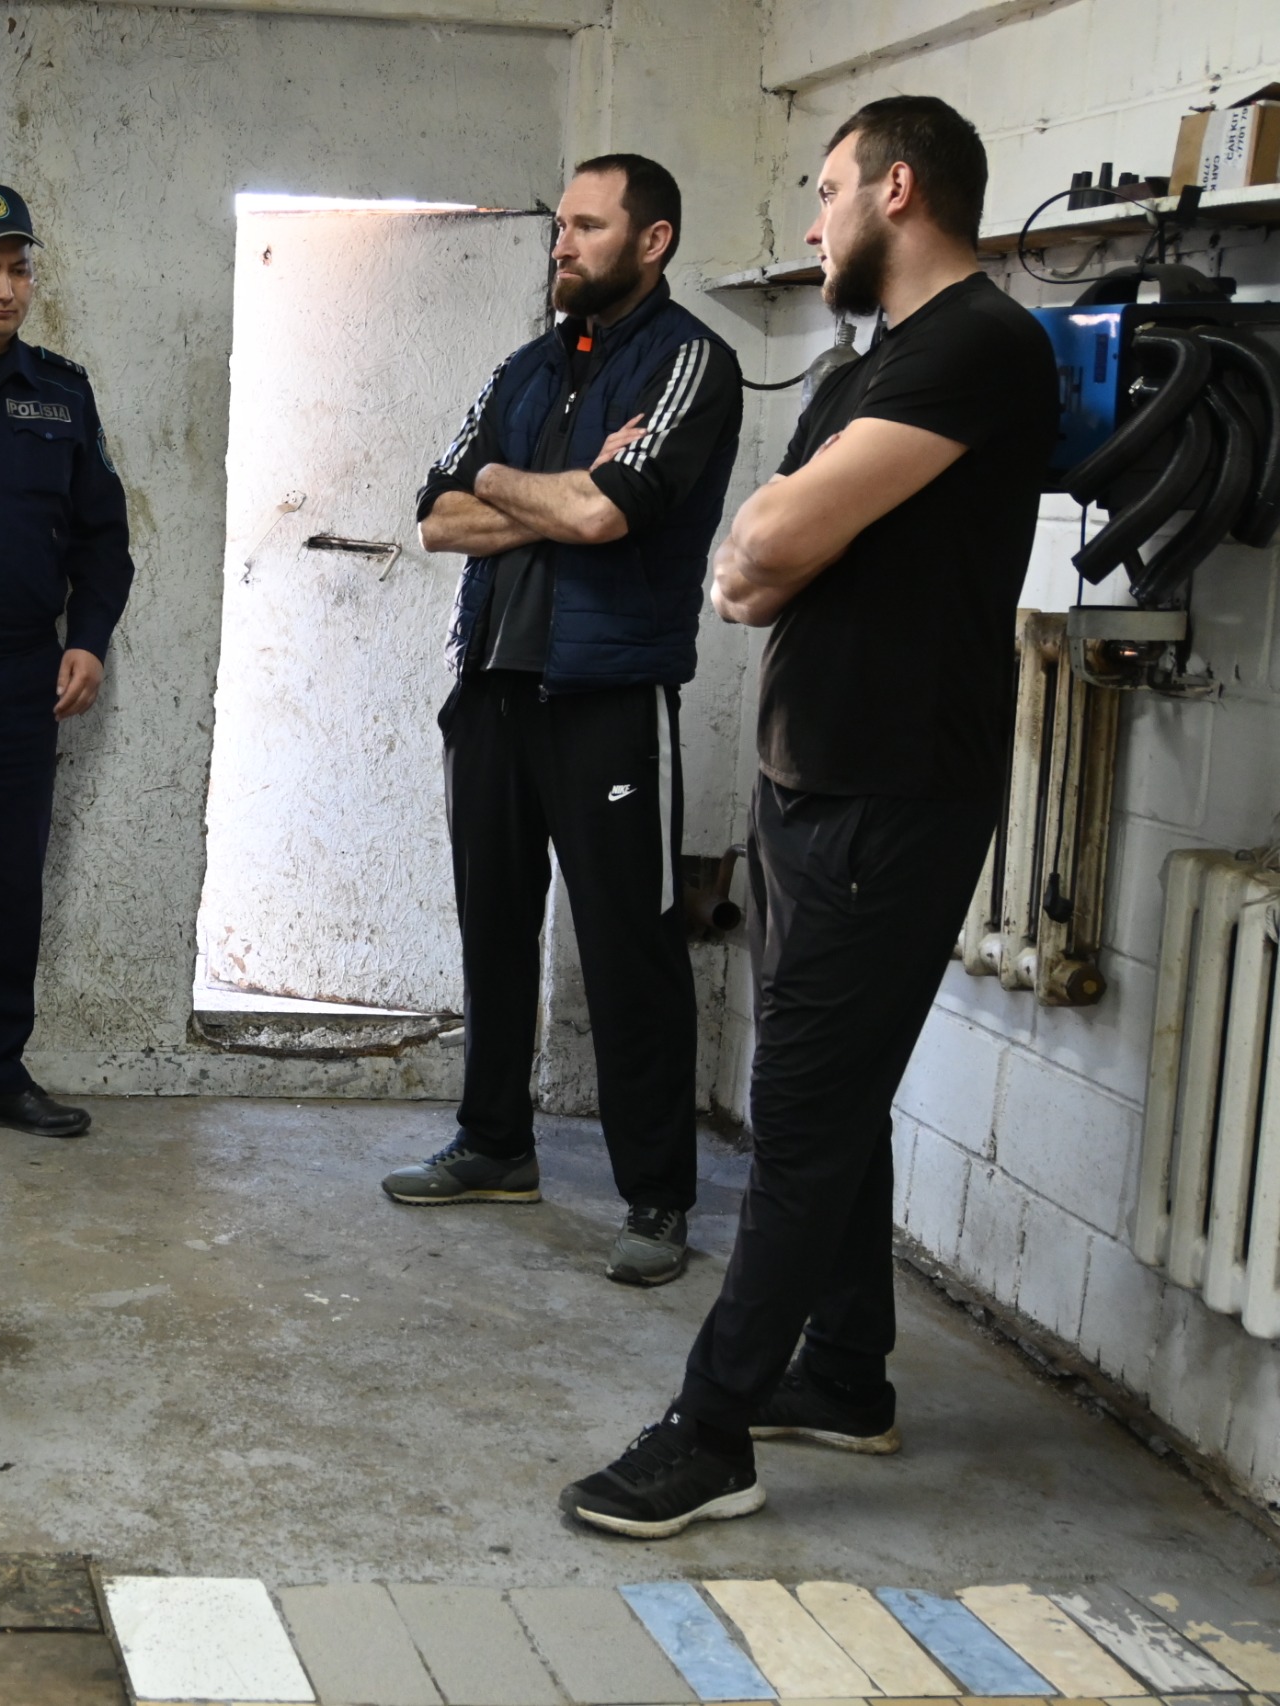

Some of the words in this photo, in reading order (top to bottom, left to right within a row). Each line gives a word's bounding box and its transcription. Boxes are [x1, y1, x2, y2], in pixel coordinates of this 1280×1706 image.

[1230, 113, 1239, 132] KIT
[1226, 135, 1236, 161] CAR
[1211, 155, 1220, 180] CAR
[612, 784, 631, 794] NIKE
